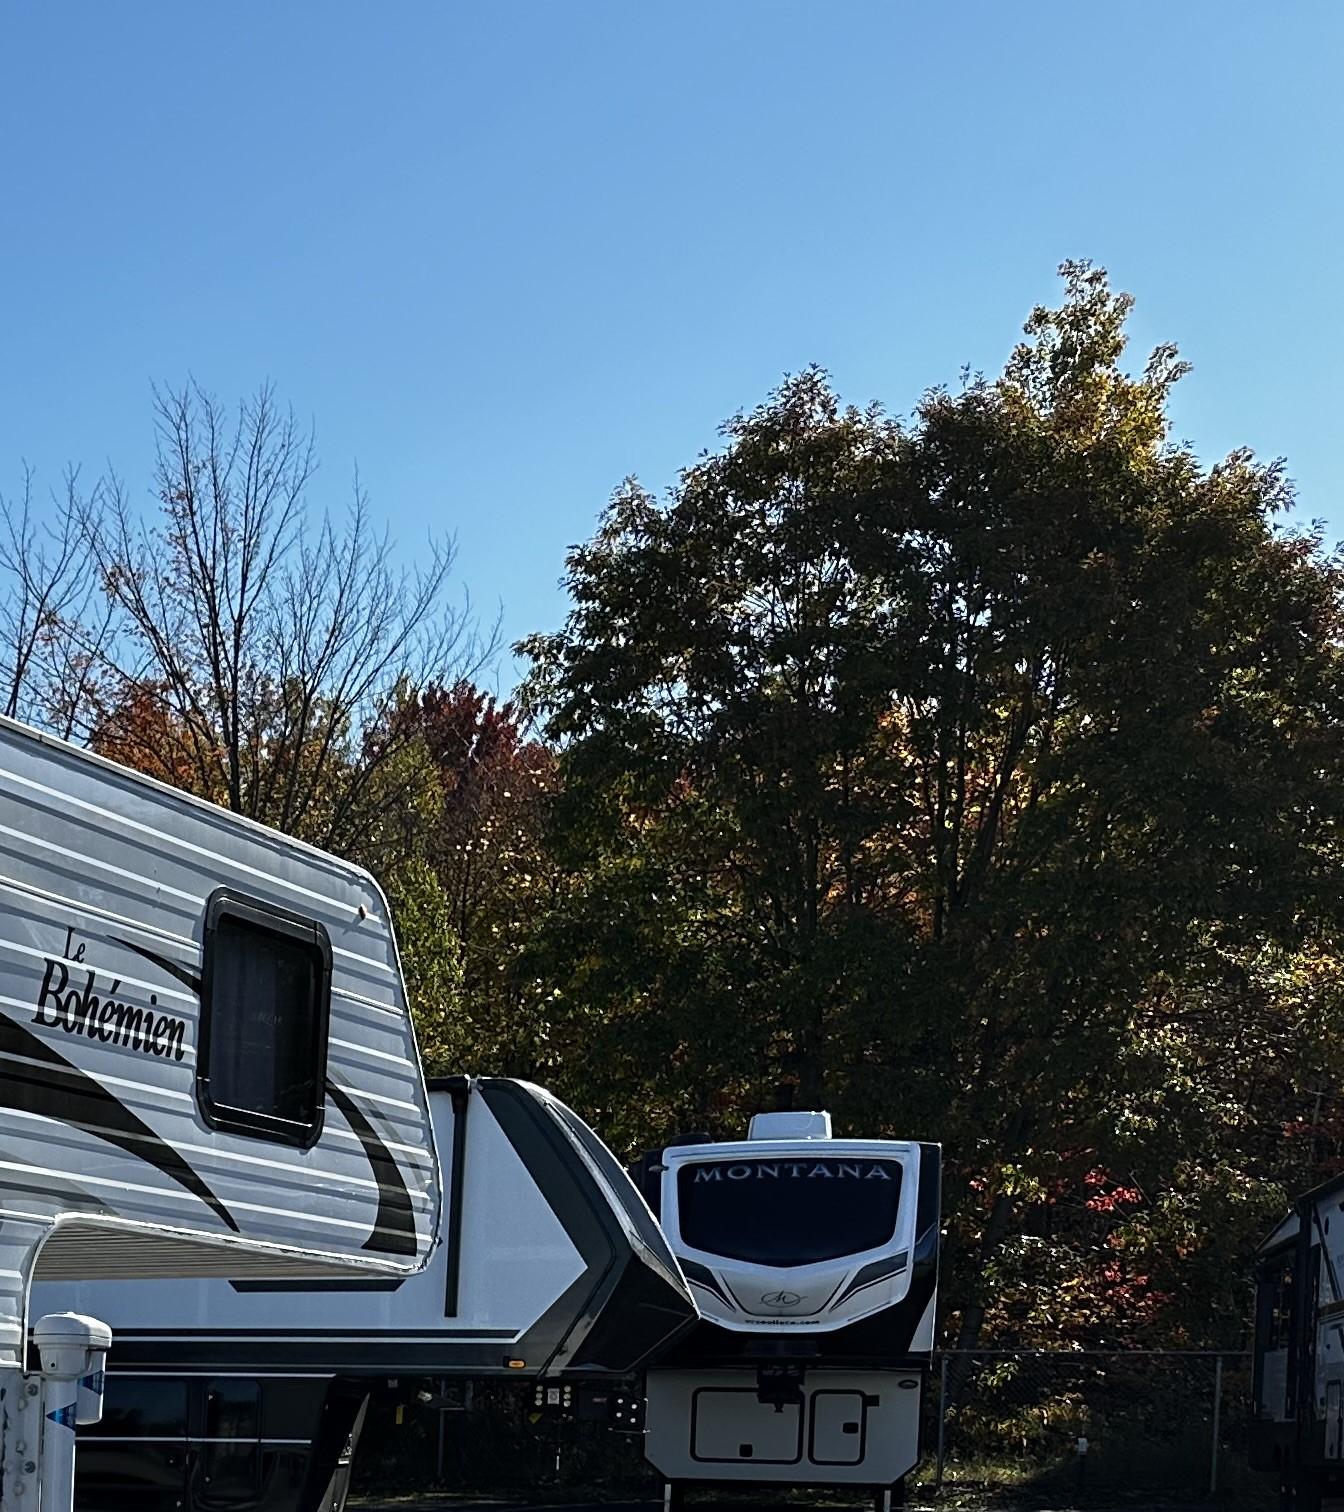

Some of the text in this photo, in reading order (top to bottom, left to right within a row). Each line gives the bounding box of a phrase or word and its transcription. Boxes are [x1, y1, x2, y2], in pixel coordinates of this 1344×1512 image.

[63, 926, 86, 964] Le
[31, 957, 185, 1062] Bohémien
[694, 1163, 892, 1183] MONTANA
